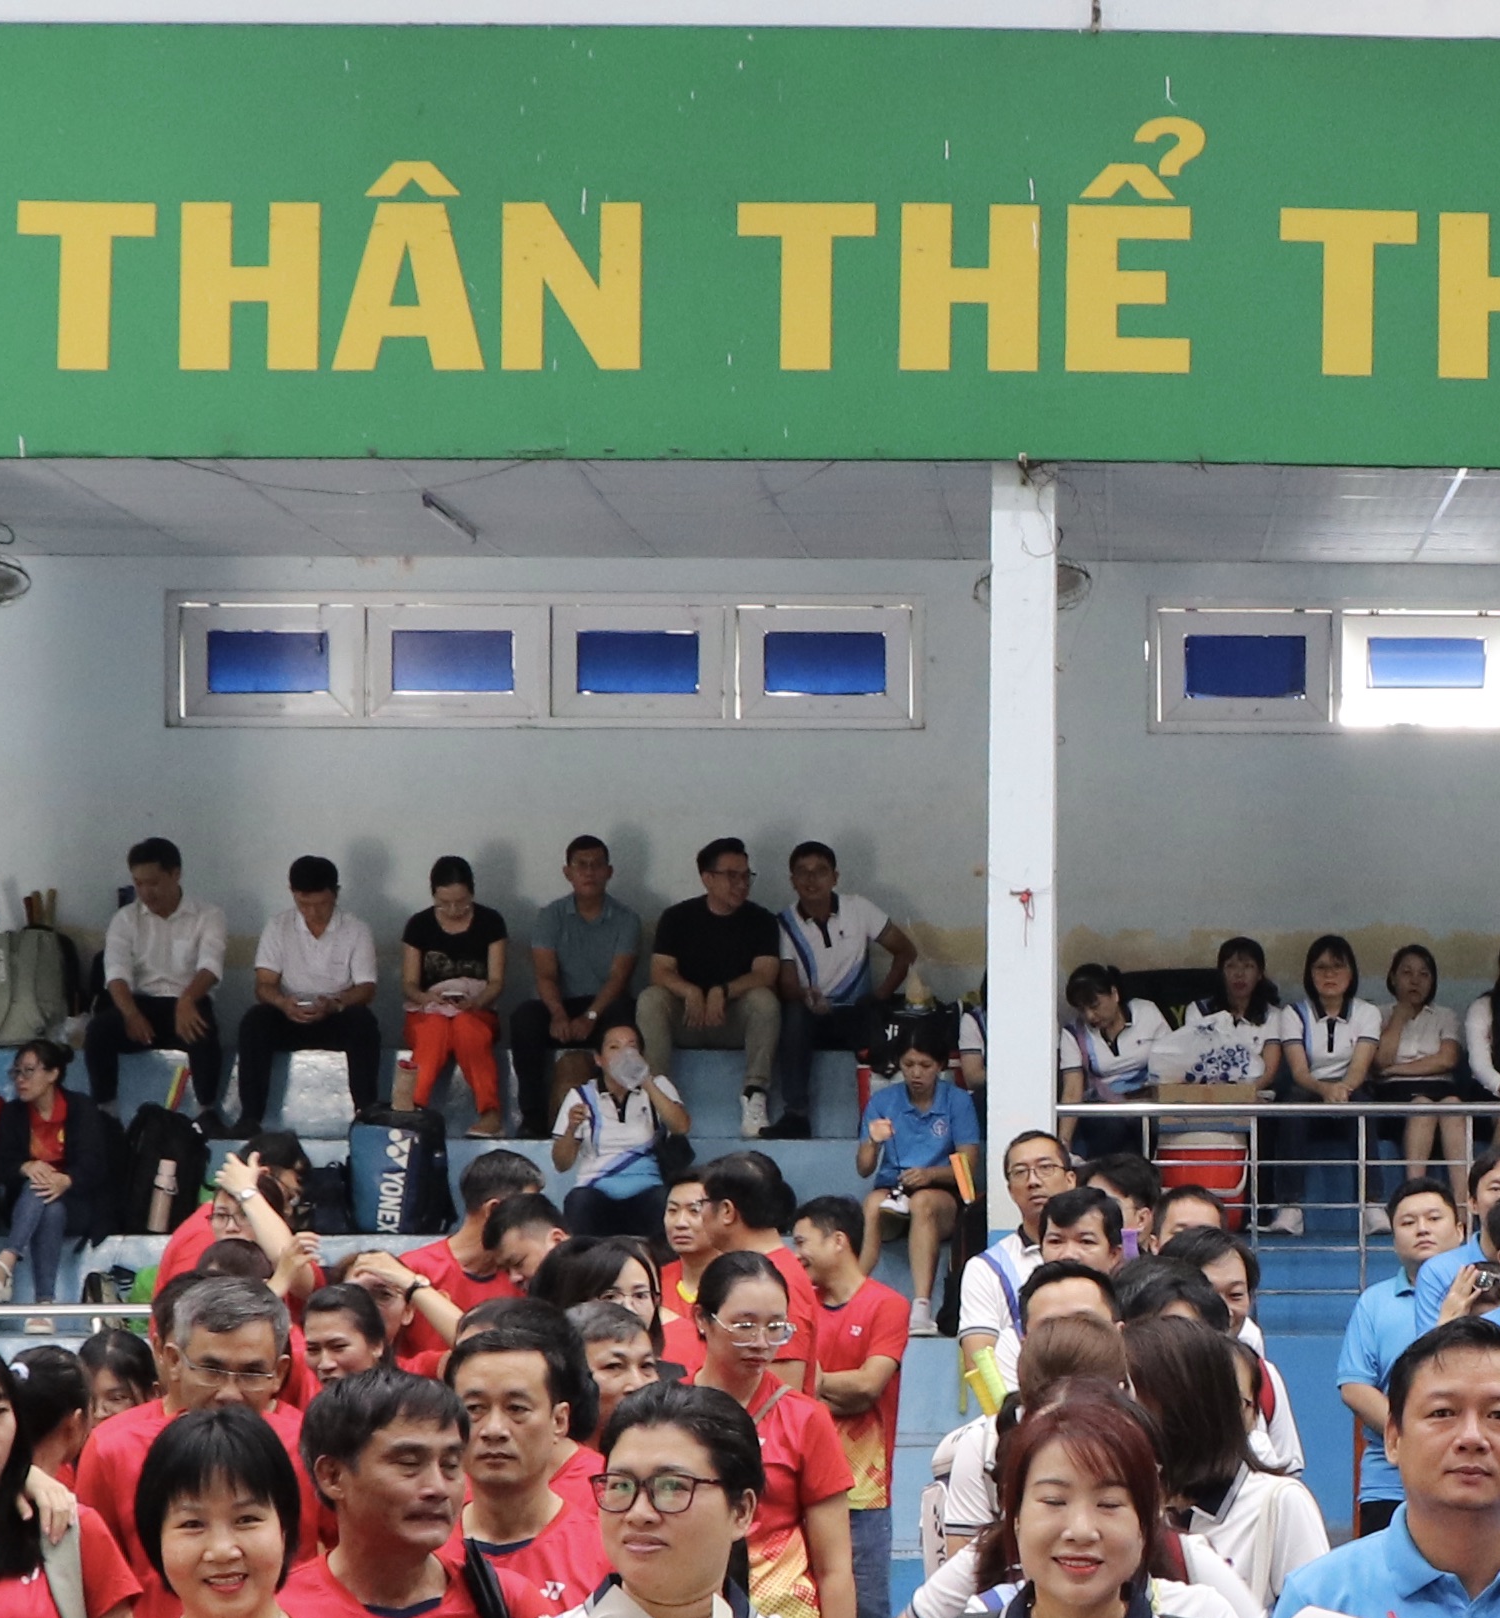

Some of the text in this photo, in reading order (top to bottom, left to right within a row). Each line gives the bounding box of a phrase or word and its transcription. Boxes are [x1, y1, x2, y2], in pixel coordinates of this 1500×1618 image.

[19, 162, 641, 370] THÂN
[739, 118, 1205, 372] THỂ
[377, 1172, 406, 1234] YONEX
